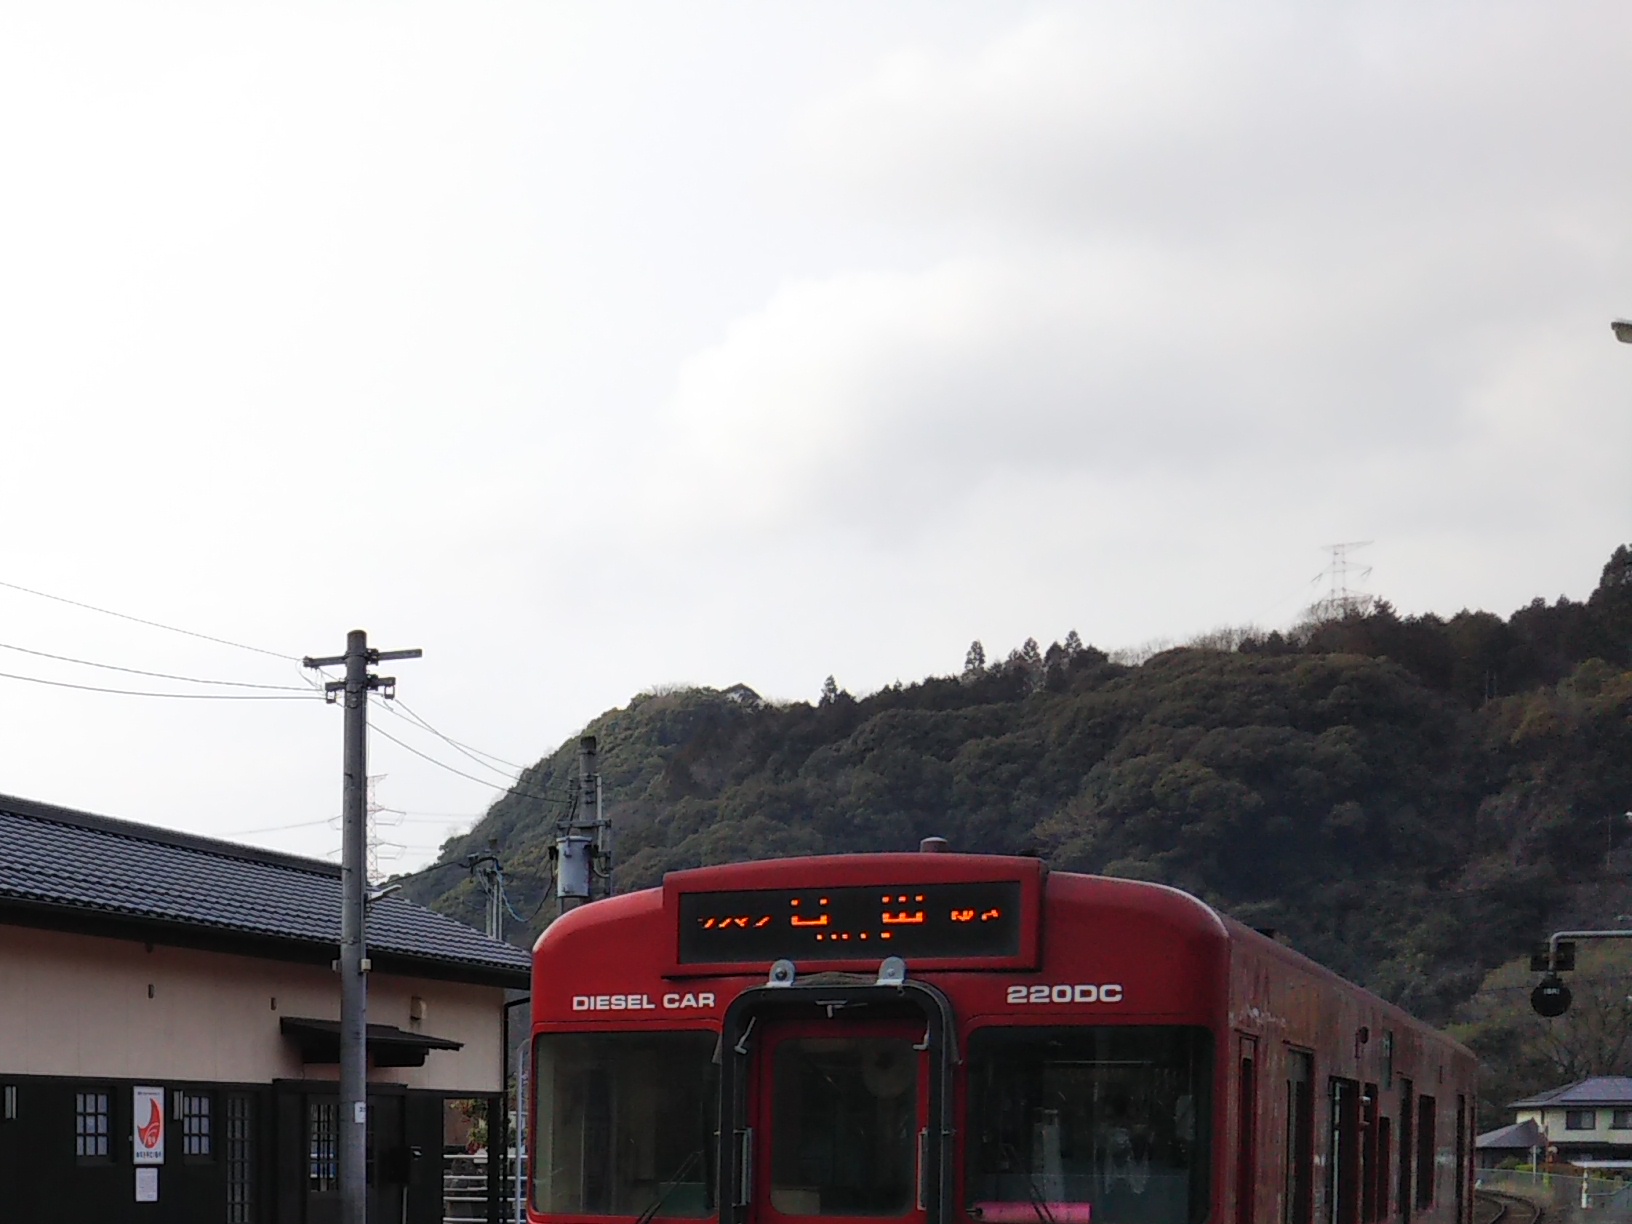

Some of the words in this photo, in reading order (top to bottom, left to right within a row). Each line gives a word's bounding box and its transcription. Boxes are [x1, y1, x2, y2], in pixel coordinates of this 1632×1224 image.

[572, 994, 656, 1011] DIESEL
[662, 992, 715, 1009] CAR
[1006, 984, 1123, 1004] 220DC
